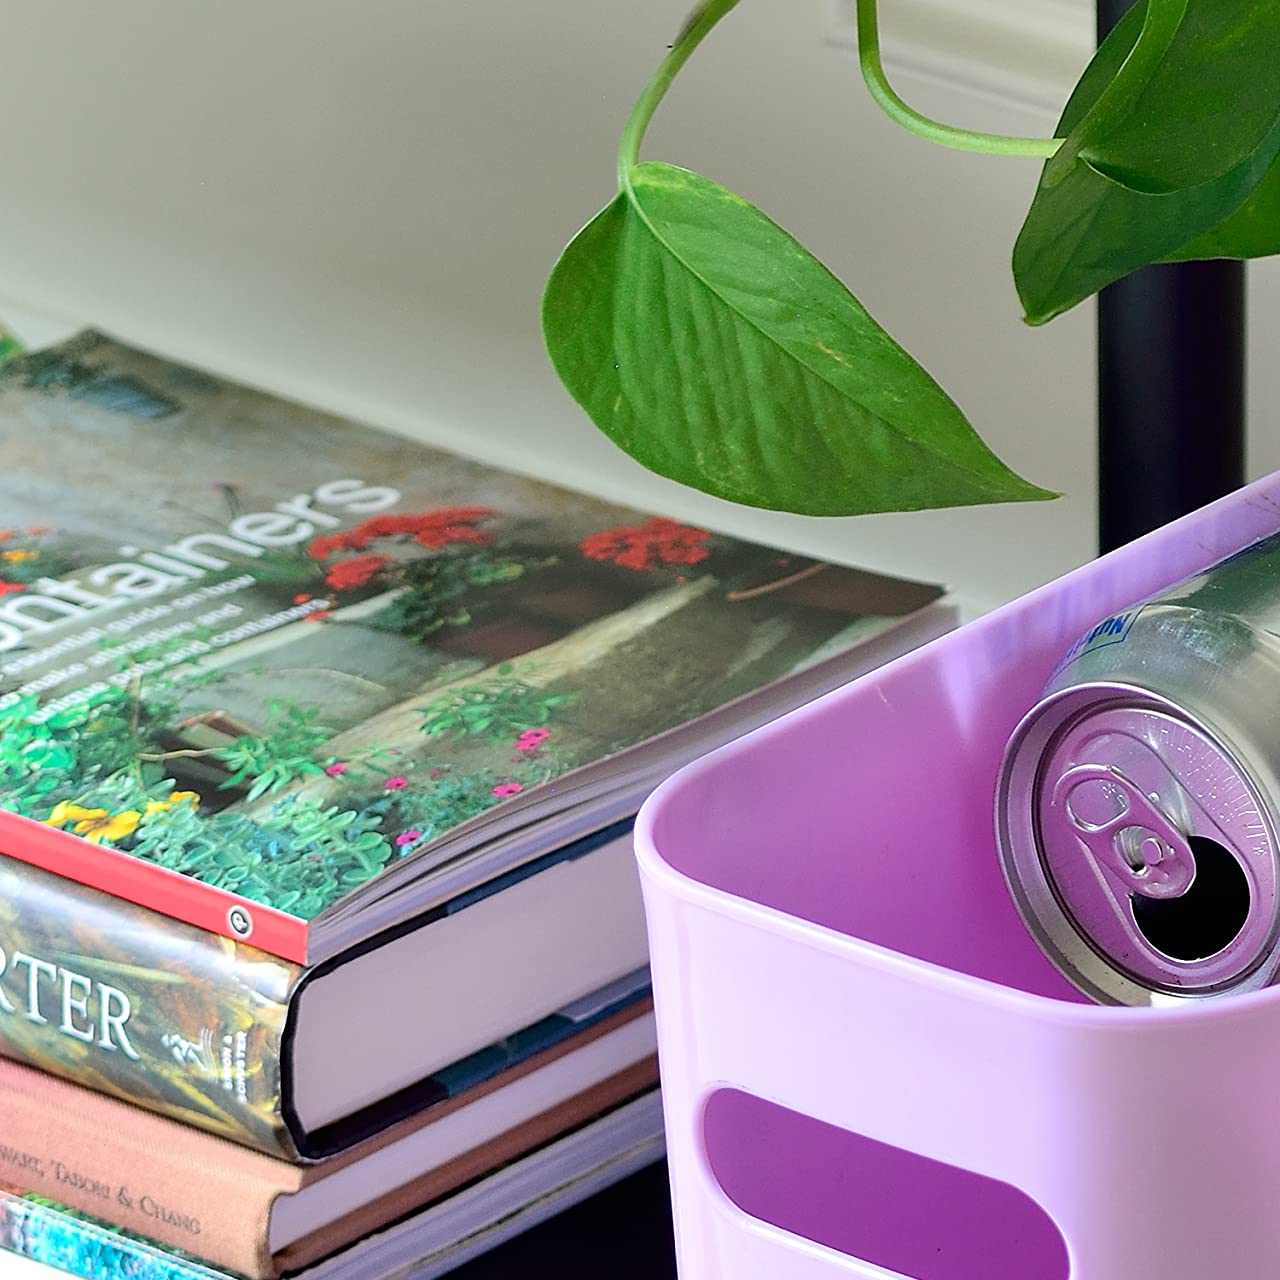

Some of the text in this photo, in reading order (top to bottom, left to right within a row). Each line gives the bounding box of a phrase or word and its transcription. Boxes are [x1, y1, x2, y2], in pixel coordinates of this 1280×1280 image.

[0, 478, 402, 653] ntainers
[105, 604, 174, 634] guide
[20, 664, 89, 695] make
[194, 603, 244, 625] and
[27, 681, 111, 724] unique
[208, 599, 332, 647] containers
